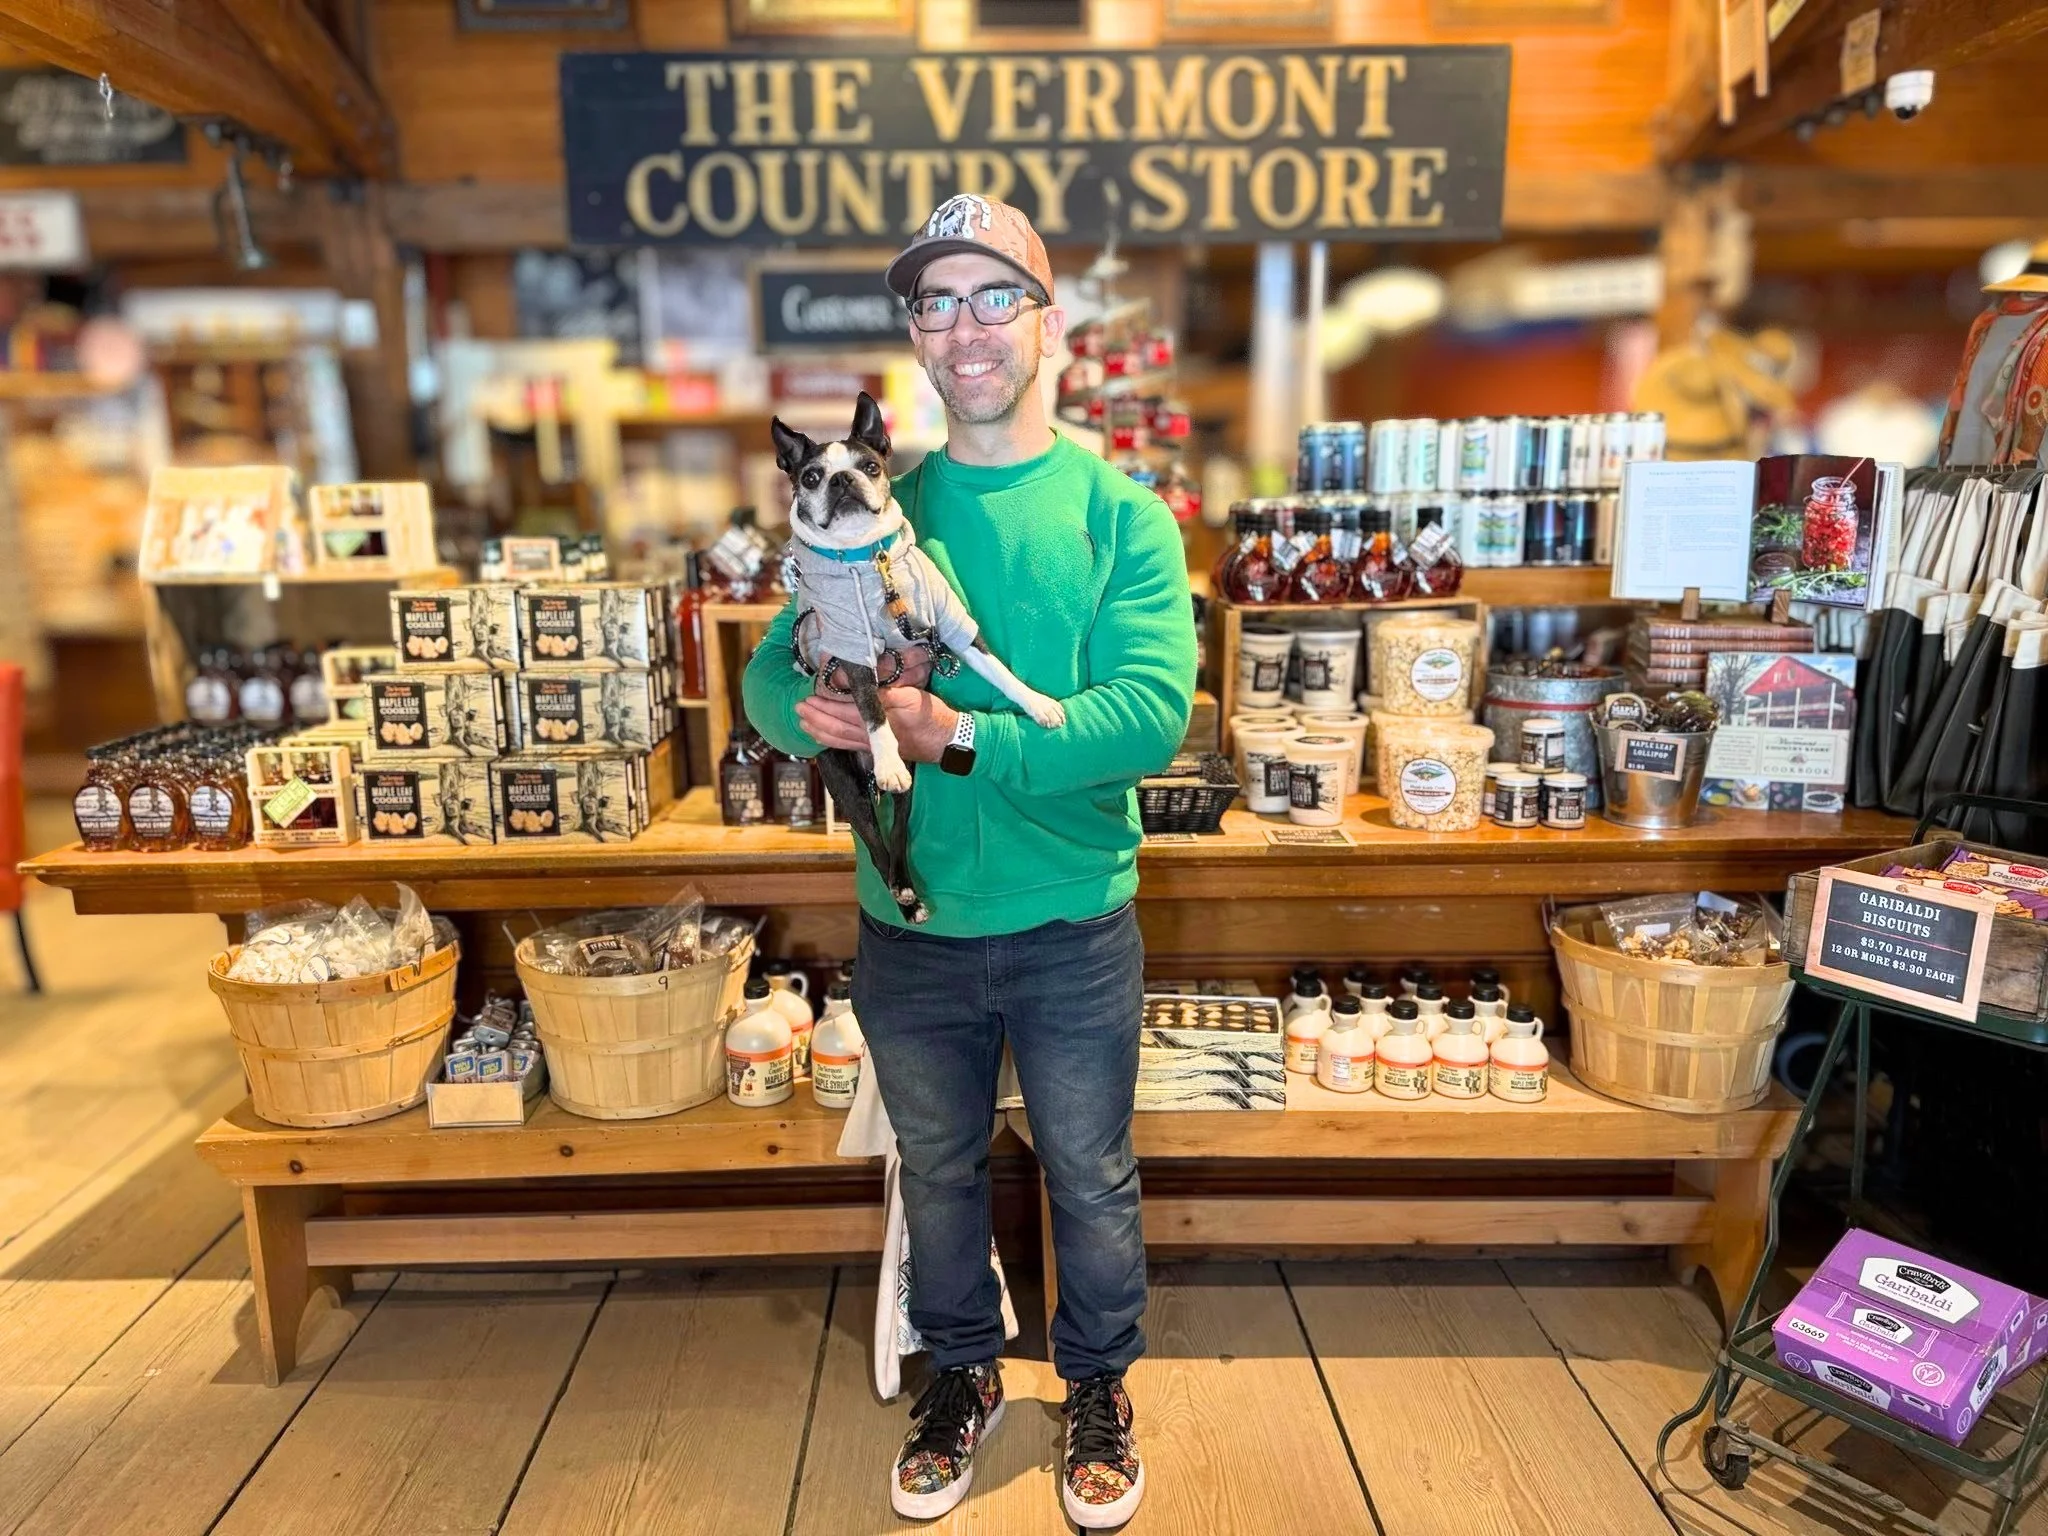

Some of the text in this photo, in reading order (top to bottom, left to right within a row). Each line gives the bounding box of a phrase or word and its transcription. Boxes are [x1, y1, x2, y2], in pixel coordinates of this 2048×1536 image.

[664, 54, 1407, 146] THE VERMONT
[625, 145, 1448, 238] COUNTRY STORE
[405, 612, 445, 621] MAPLE LEAF
[535, 610, 575, 620] MAPLE LEAF
[406, 621, 445, 629] COOKIES
[536, 620, 575, 628] COOKIES
[379, 697, 419, 707] MAPLE LEAF
[535, 694, 576, 704] MAPLE LEAF
[380, 707, 420, 715] COOKIES
[1630, 740, 1653, 749] MAPLE
[1633, 749, 1669, 759] LOLLIPOP
[1764, 766, 1830, 775] COOKBOOK
[508, 784, 550, 795] MAPLE LEAF
[728, 782, 757, 792] MAPLE
[778, 780, 806, 789] MAPLE
[371, 786, 413, 797] MAPLE LEAF
[372, 796, 414, 805] COOKIES
[509, 795, 551, 803] COOKIES
[1860, 892, 1941, 921] GARIBALDI
[1862, 911, 1930, 938] BISCUITS
[1860, 937, 1927, 962] $3.70 EACH
[1831, 943, 1955, 984] 12 OR MORE $3.30 EACH
[765, 1072, 783, 1085] MAPLE
[830, 1080, 850, 1089] SYRUP
[1898, 1266, 1949, 1291] Crawford's
[1875, 1273, 1953, 1312] Garibaldi
[1791, 1322, 1825, 1339] 63669
[1858, 1319, 1899, 1340] Garibaldi
[1824, 1373, 1880, 1404] Garibaldi
